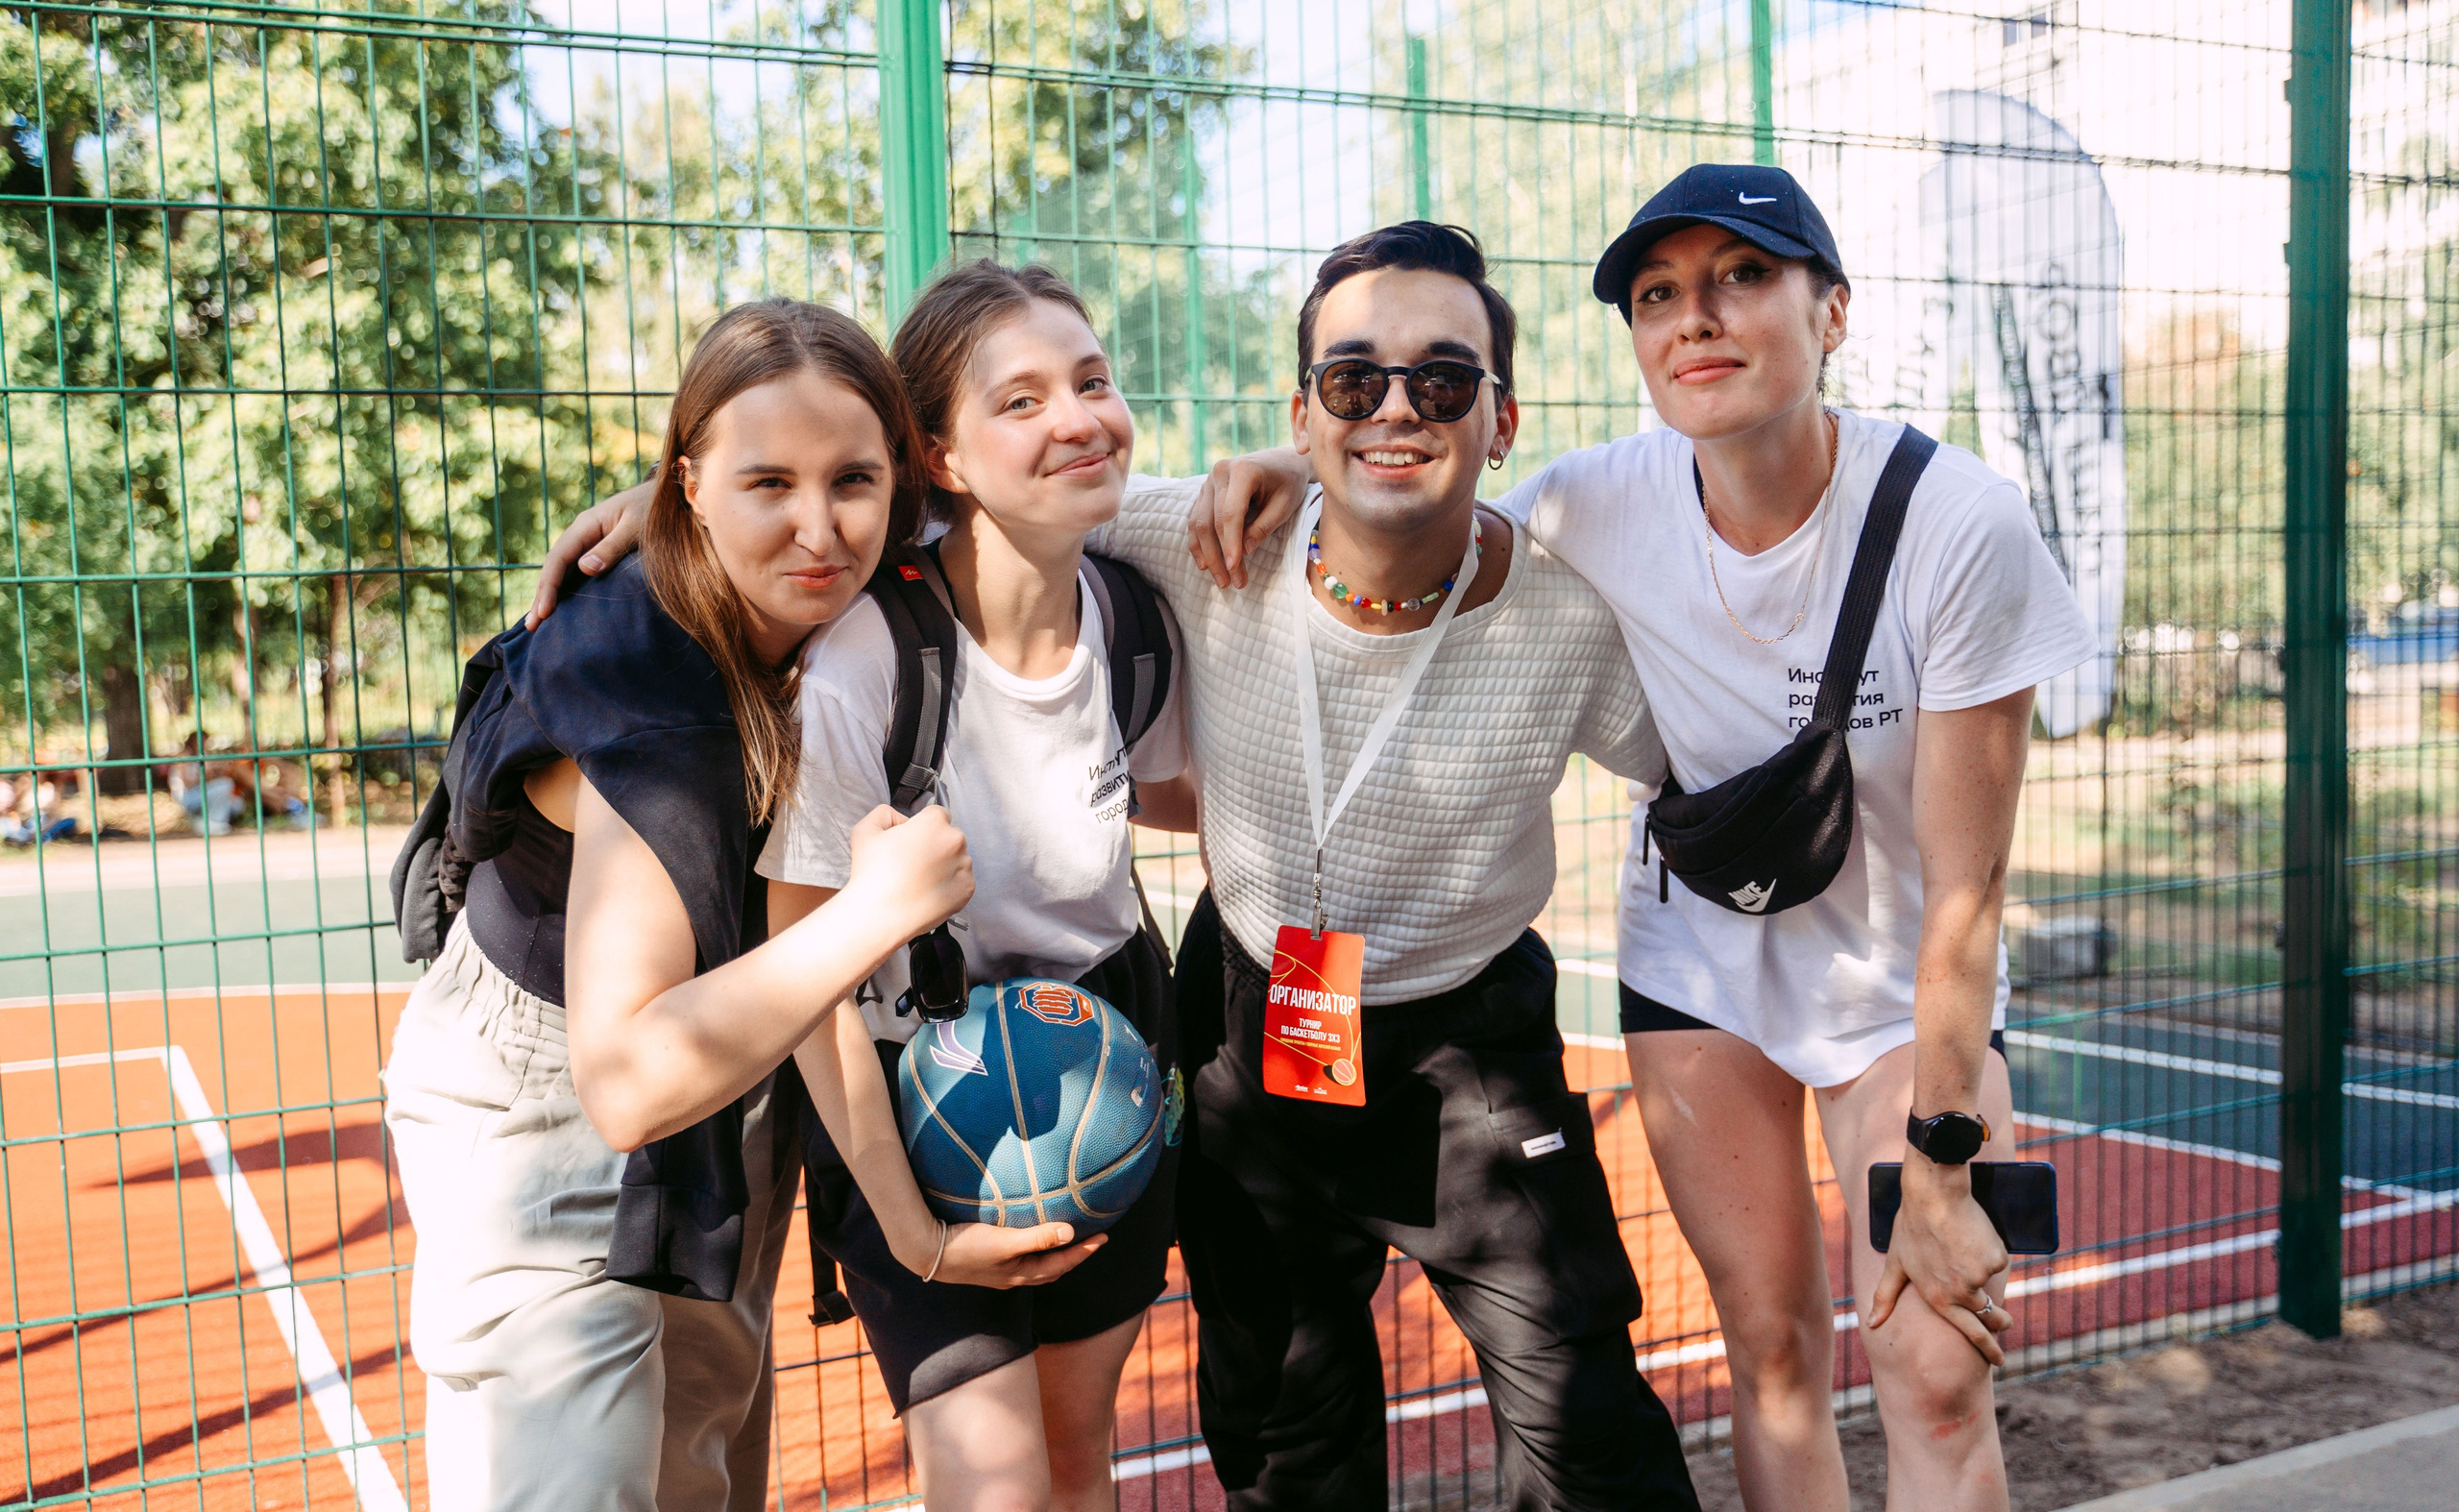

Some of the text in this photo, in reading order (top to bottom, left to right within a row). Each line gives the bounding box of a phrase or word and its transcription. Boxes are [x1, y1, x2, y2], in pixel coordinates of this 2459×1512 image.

[1788, 668, 1880, 686] Инсут
[1789, 693, 1885, 709] ратия
[1789, 708, 1904, 732] гоов РТ
[1728, 880, 1764, 906] NIKE
[1269, 984, 1357, 1015] ОРГАНИЗАТОР
[1299, 1017, 1322, 1030] ТУРНИР
[1280, 1025, 1290, 1036] ПО
[1289, 1026, 1327, 1042] БАСКЕТБОЛУ
